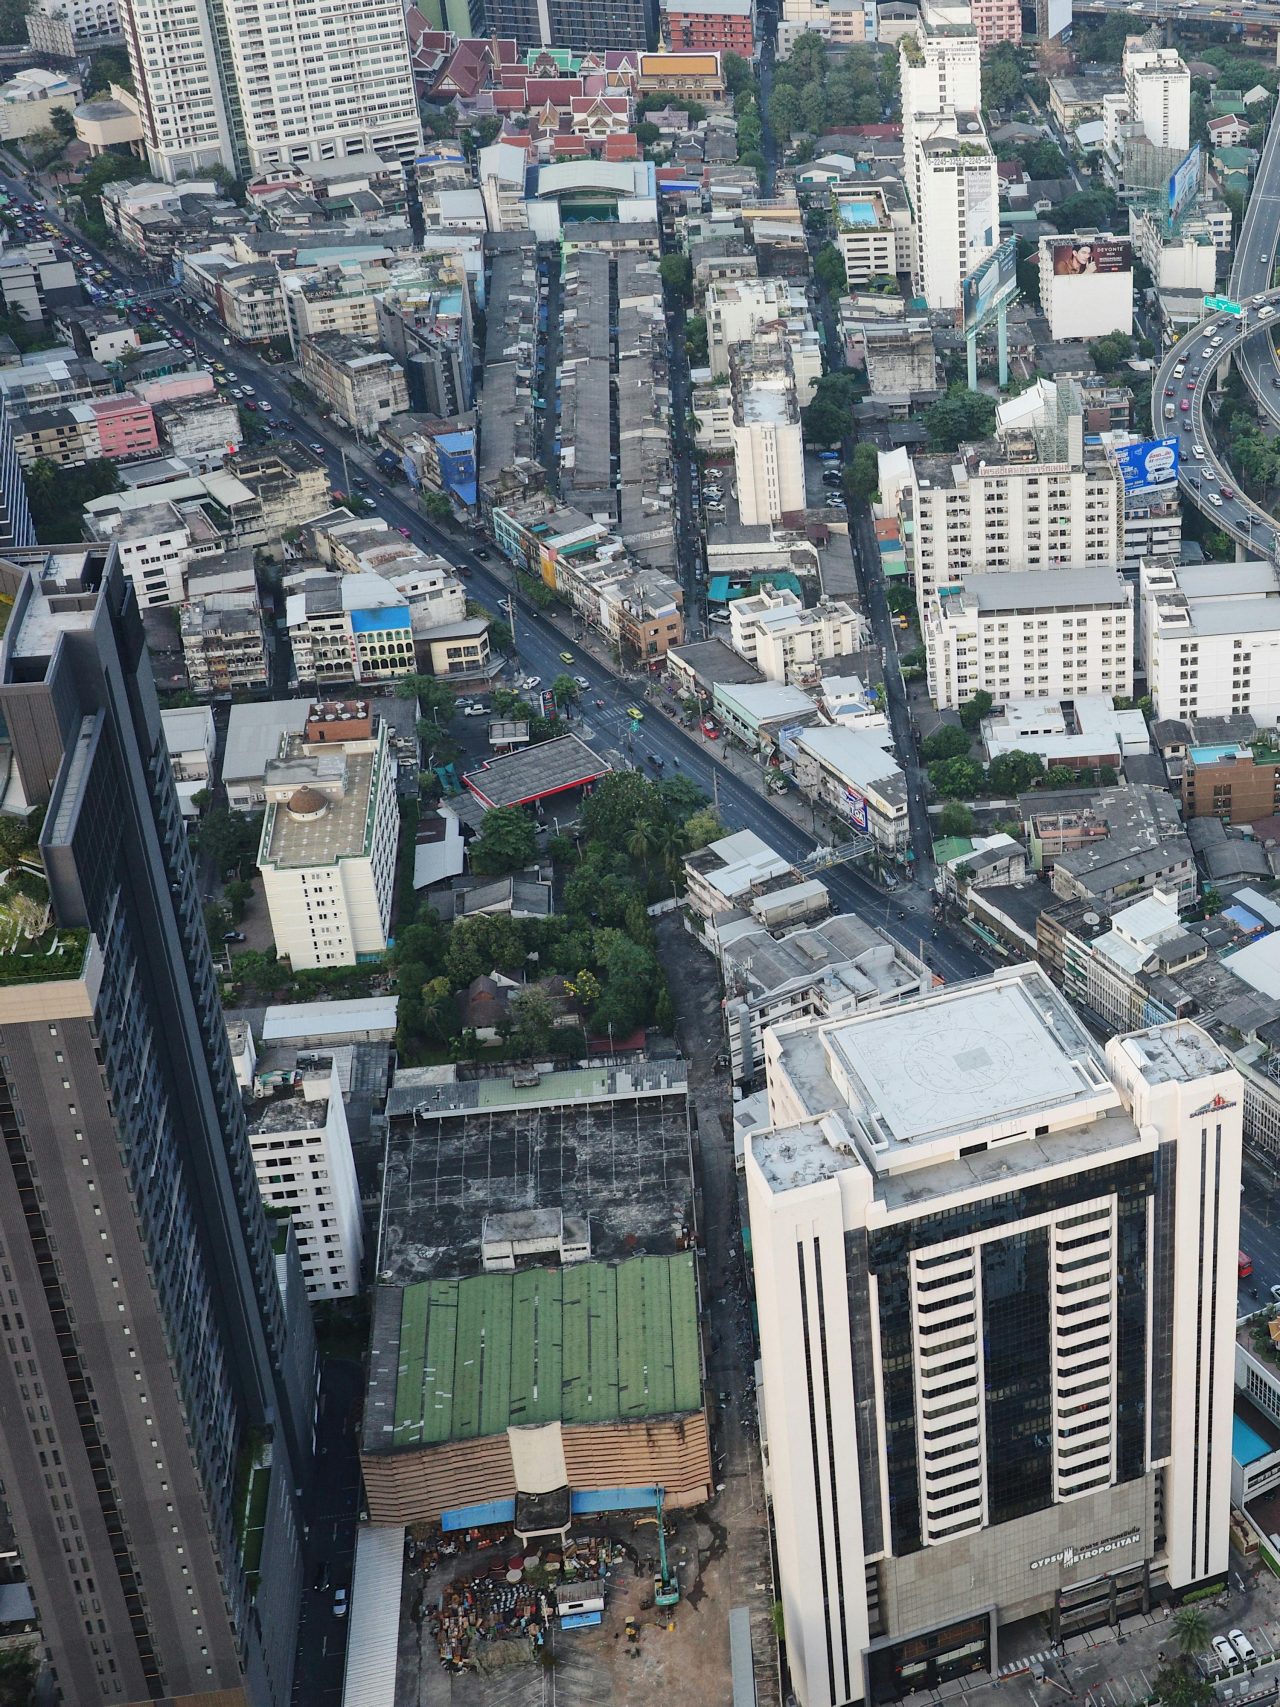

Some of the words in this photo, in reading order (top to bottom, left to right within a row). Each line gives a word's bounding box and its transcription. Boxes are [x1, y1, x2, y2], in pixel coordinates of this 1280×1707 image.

[305, 289, 337, 299] SEASONS
[851, 805, 864, 822] TOA
[1189, 1101, 1237, 1118] SAINT-GOBAIN
